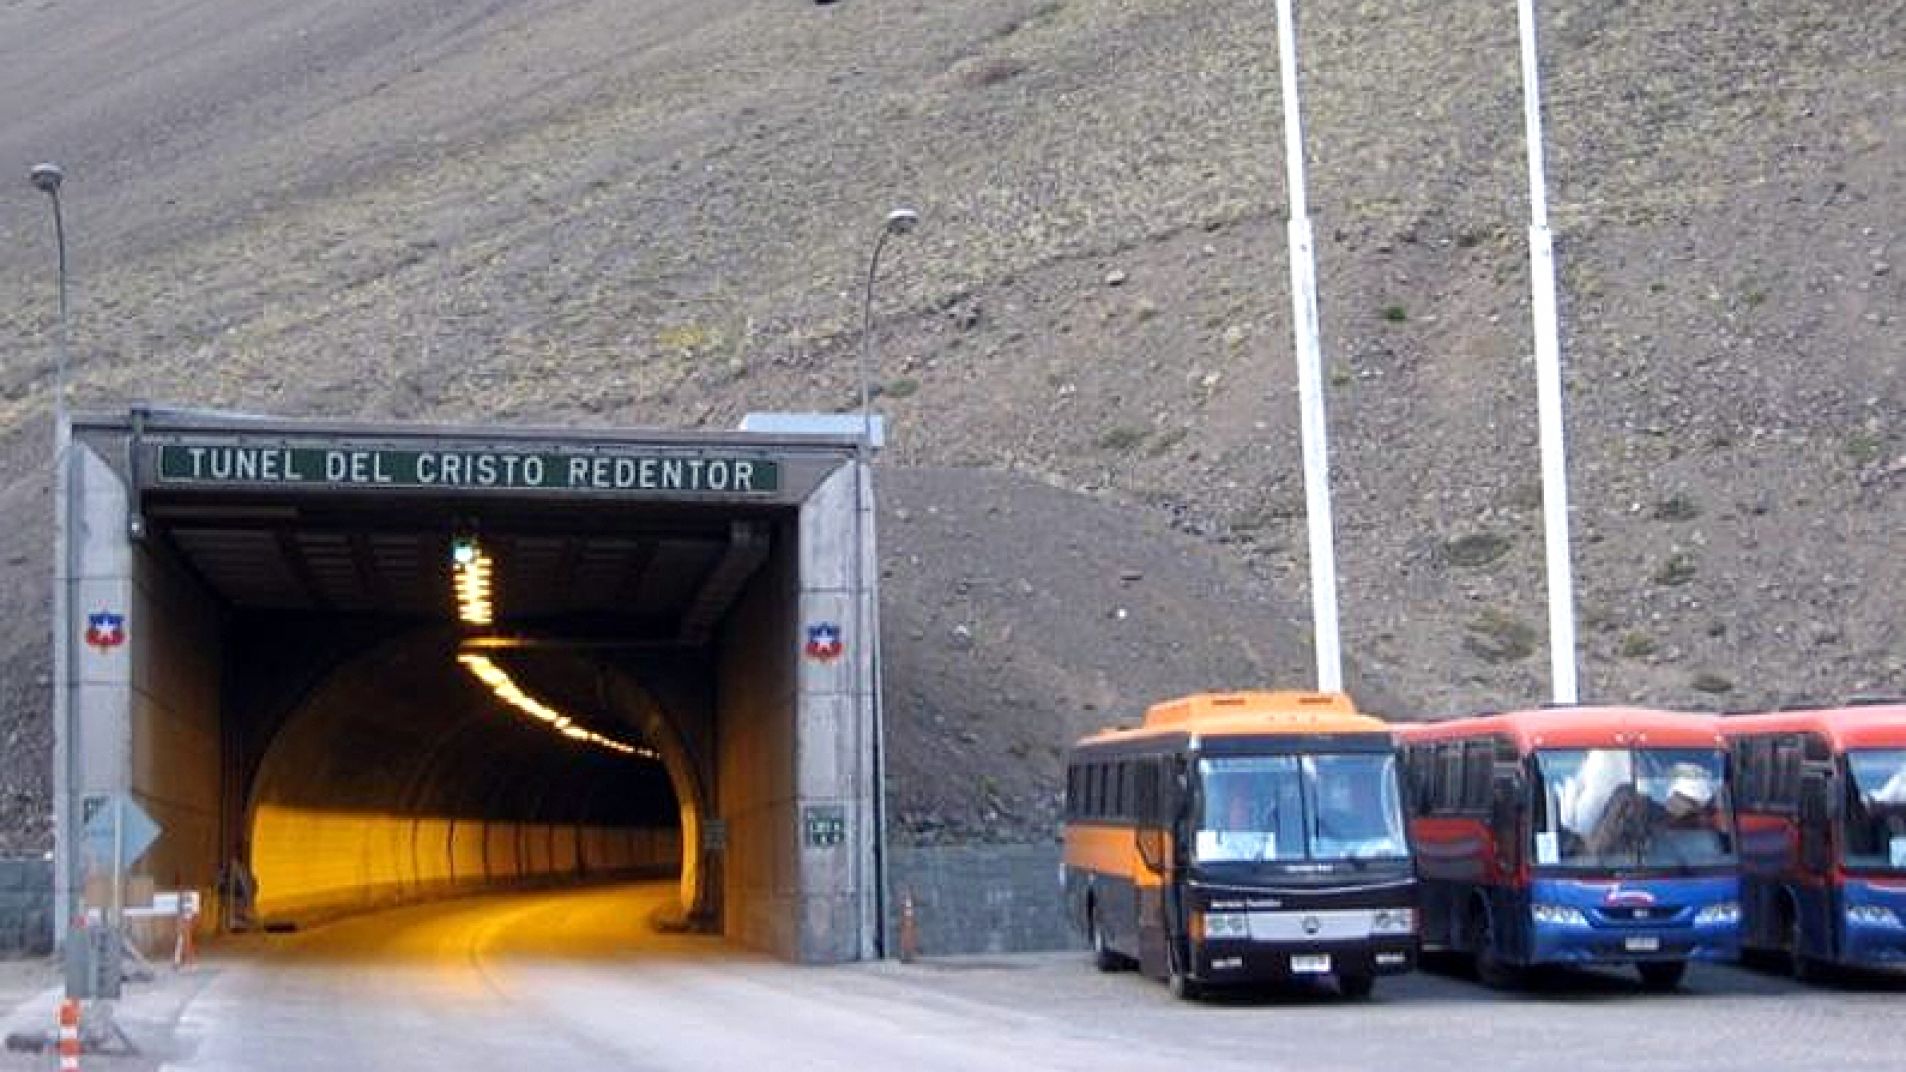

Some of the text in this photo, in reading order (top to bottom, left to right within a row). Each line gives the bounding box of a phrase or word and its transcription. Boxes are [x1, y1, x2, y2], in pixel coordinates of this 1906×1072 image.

[188, 448, 754, 490] TUNEL DEL CRISTO REDENTOR
